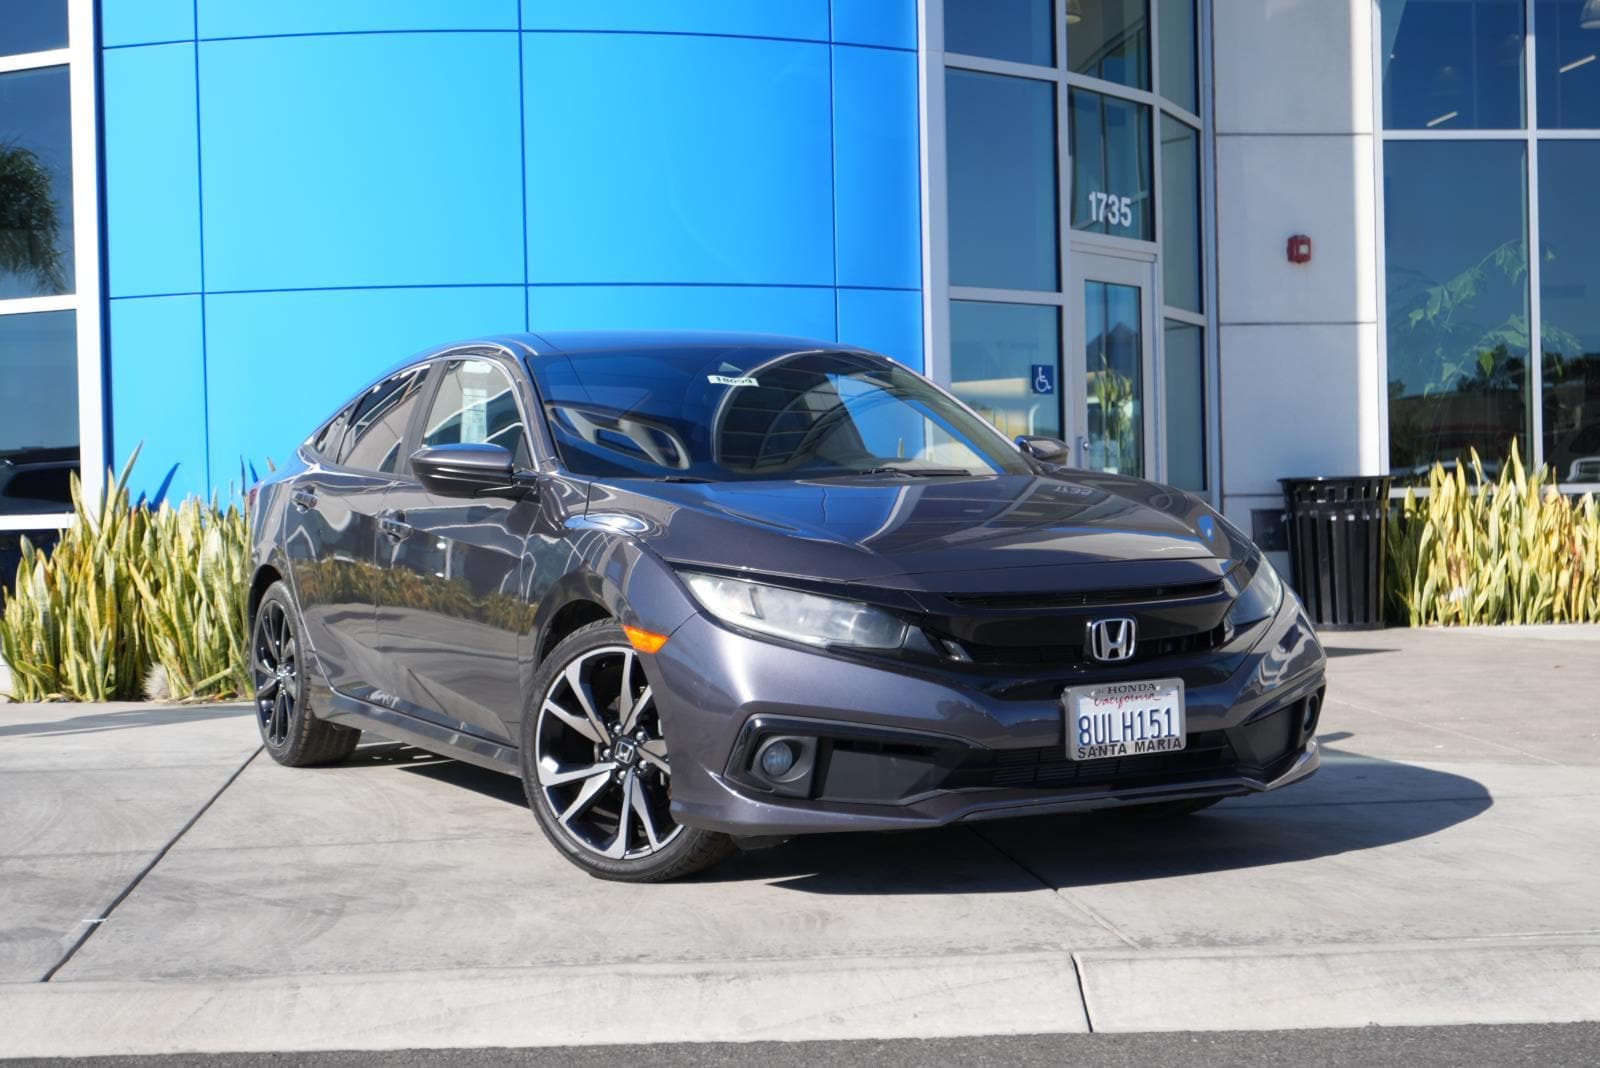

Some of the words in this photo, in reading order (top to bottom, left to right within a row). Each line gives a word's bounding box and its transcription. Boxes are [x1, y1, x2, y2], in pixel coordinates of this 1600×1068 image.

[1089, 191, 1131, 227] 1735
[1108, 683, 1156, 694] HONDA
[1078, 707, 1176, 746] 8ULH151
[1078, 743, 1127, 759] SANTA
[1135, 738, 1182, 753] MARIA
